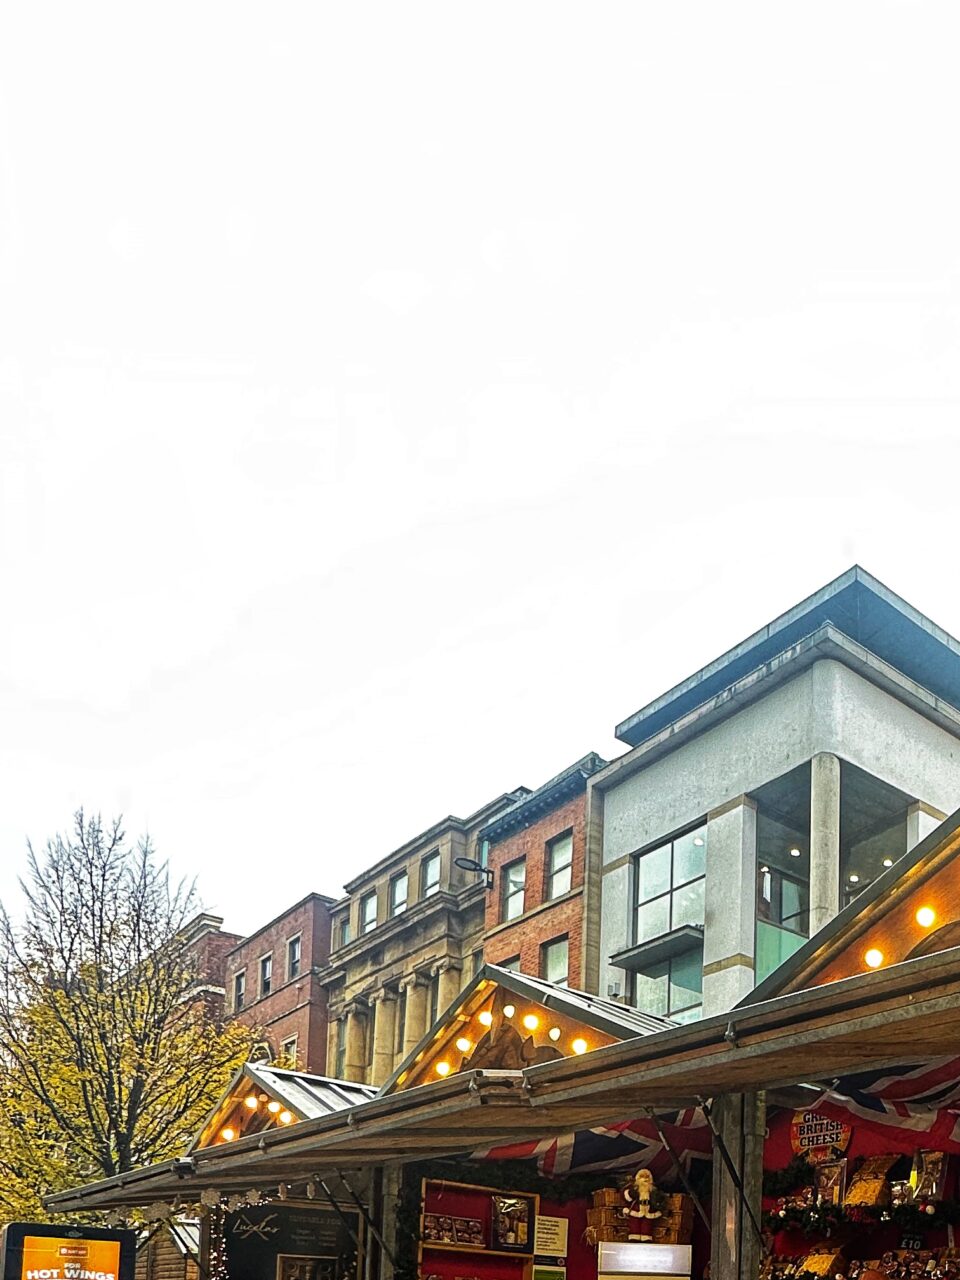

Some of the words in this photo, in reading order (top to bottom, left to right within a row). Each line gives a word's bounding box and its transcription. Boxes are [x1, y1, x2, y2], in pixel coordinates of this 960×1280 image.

[798, 1119, 843, 1136] BRITISH
[799, 1132, 842, 1147] CHEESE
[901, 1238, 921, 1250] £10
[27, 1270, 60, 1279] HOT
